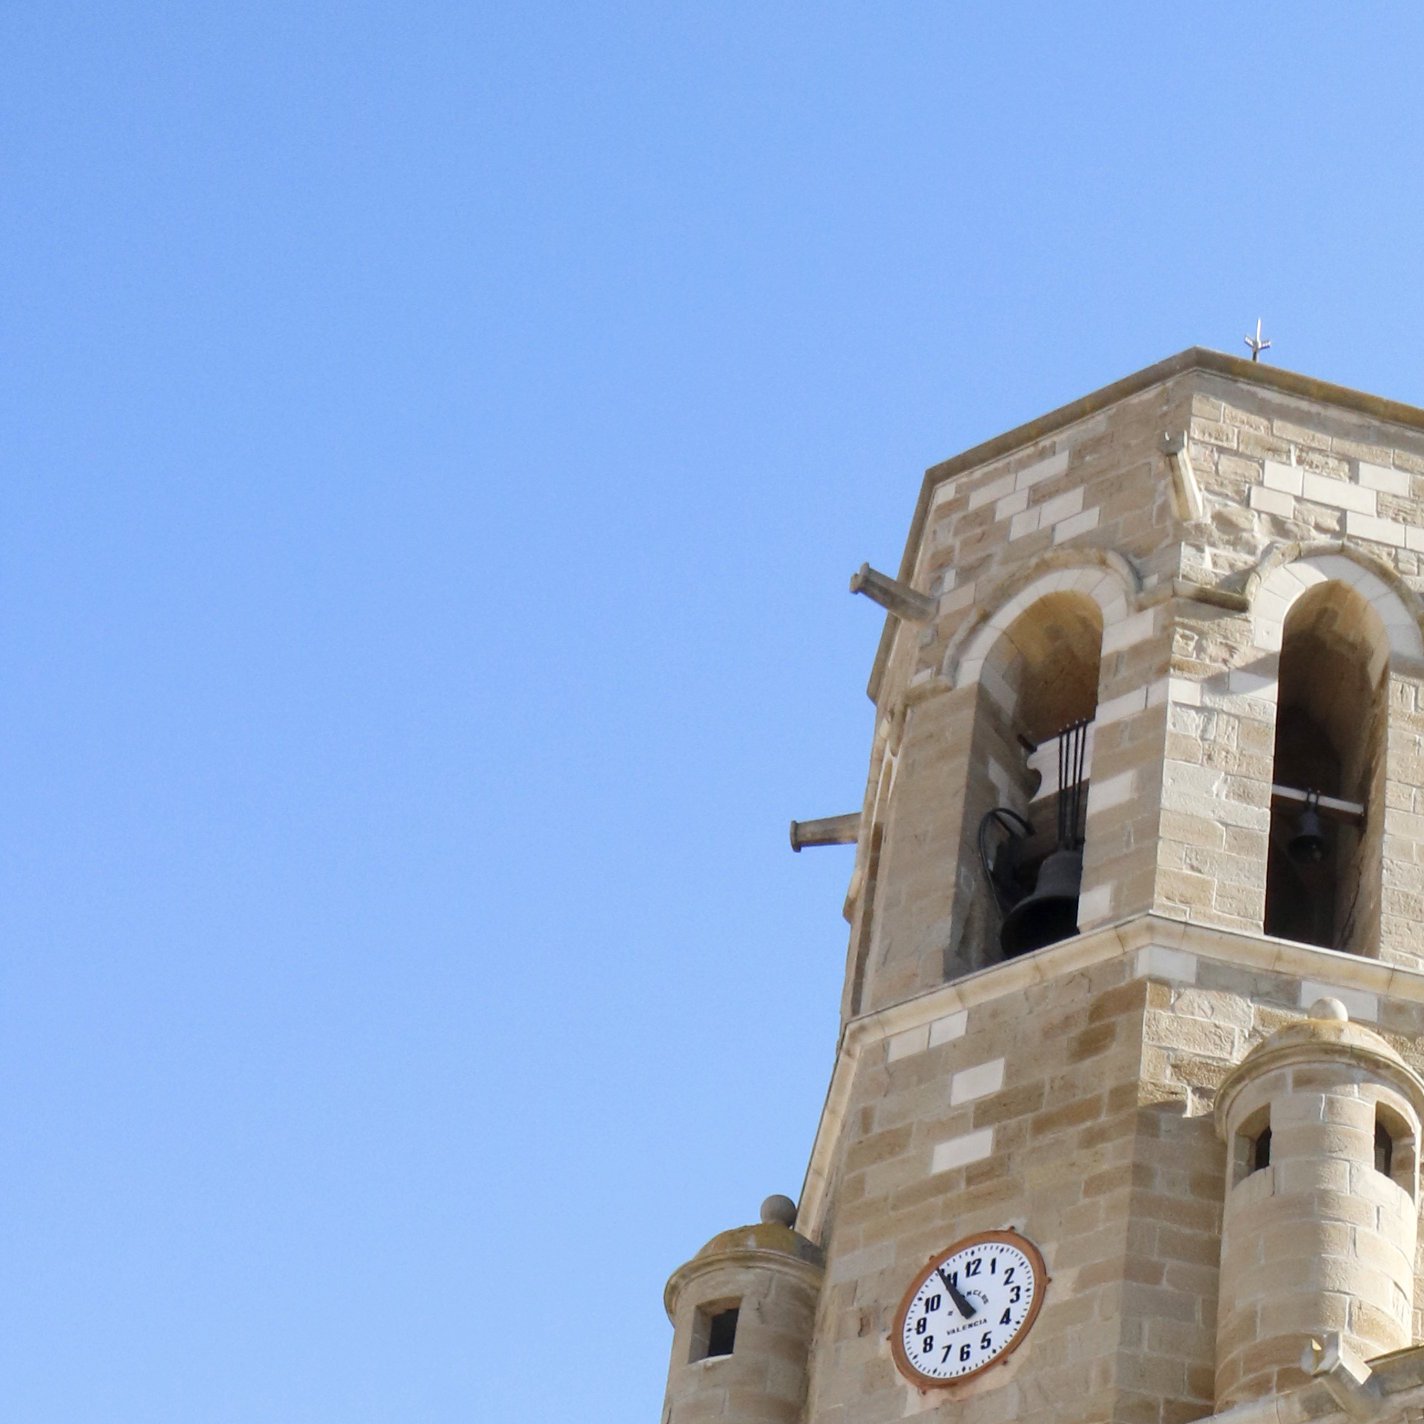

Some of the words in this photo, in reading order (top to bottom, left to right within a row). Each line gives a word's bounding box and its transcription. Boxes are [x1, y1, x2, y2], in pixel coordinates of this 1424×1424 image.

[965, 1258, 982, 1278] 12
[990, 1258, 997, 1275] 1
[1003, 1267, 1015, 1286] 2
[925, 1294, 941, 1314] 10
[1010, 1286, 1020, 1304] 3
[999, 1308, 1012, 1325] 4
[946, 1318, 988, 1336] VALENCIA
[922, 1335, 934, 1353] 8
[980, 1331, 992, 1350] 5
[941, 1344, 952, 1364] 7
[959, 1344, 971, 1362] 6
